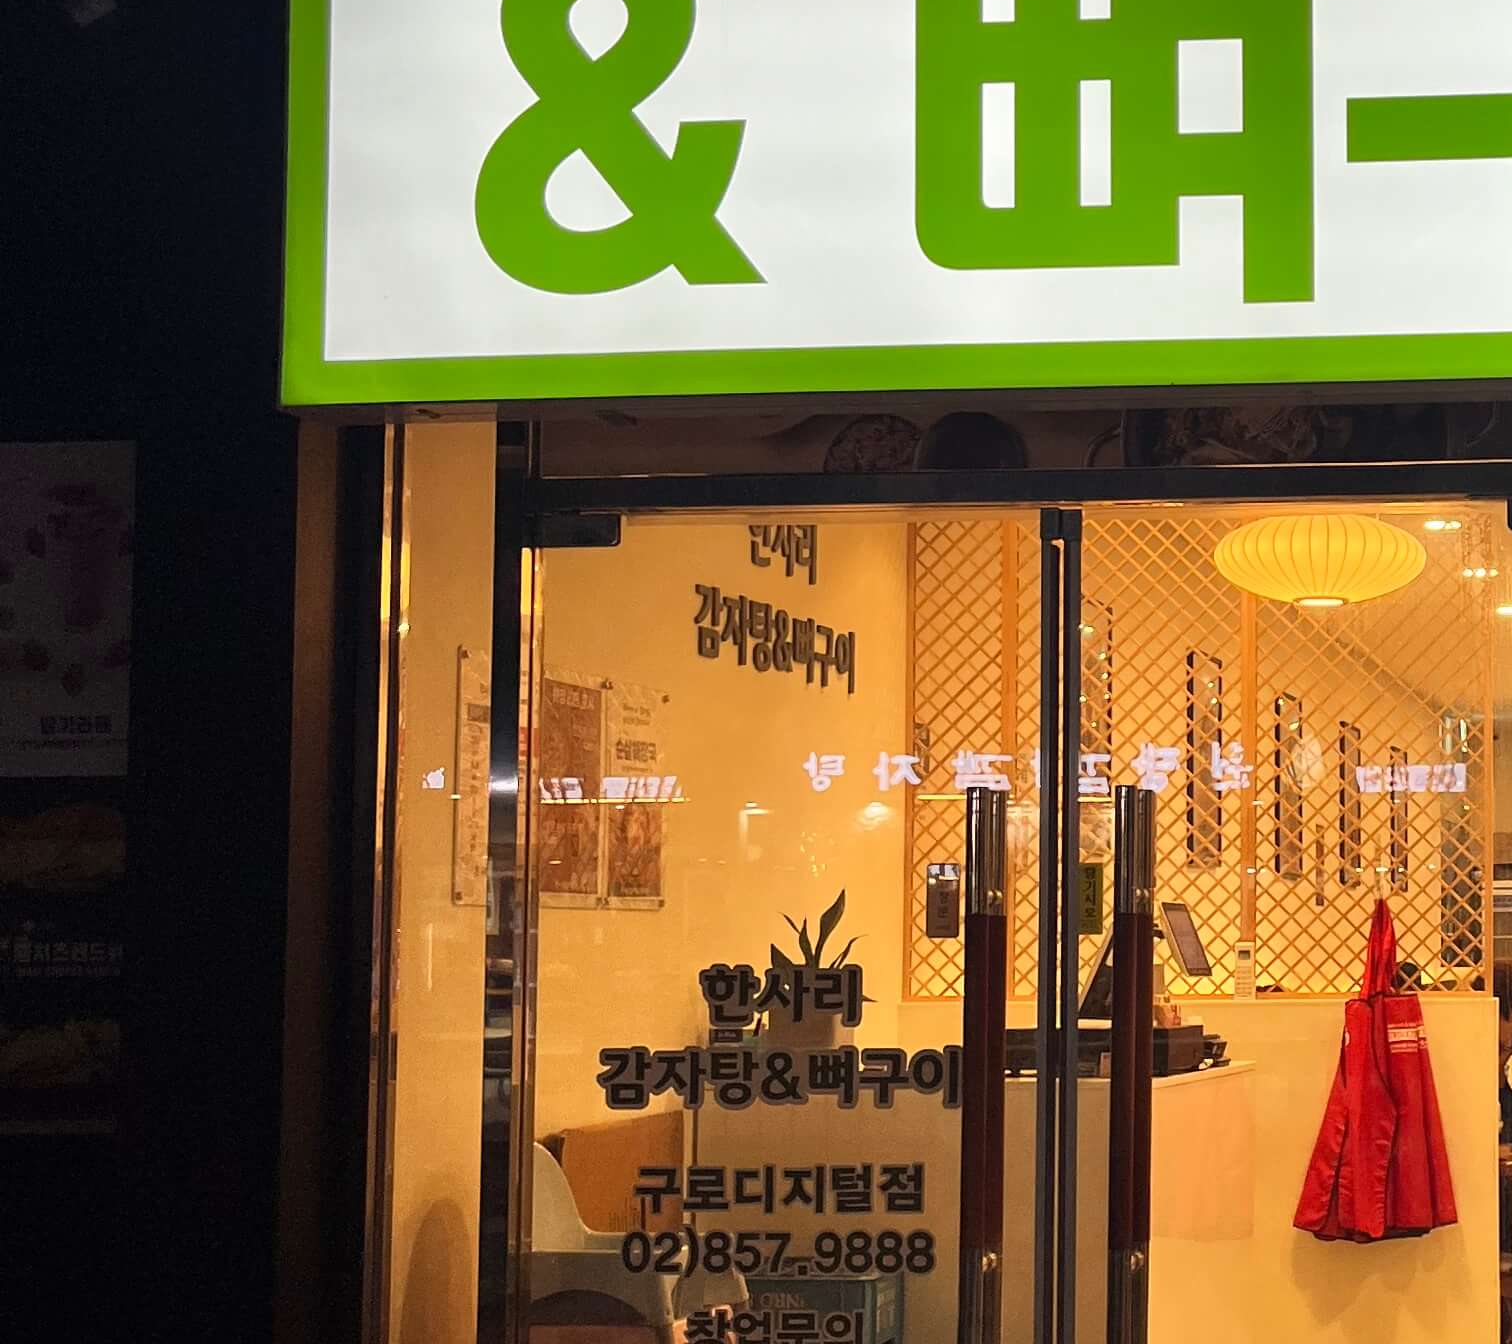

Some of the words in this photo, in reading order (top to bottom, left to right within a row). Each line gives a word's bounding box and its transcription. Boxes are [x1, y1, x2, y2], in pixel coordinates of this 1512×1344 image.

[694, 584, 856, 694] 감자탕&뼈구이
[701, 963, 863, 1026] 한사리
[597, 1045, 962, 1110] 감자탕&뼈구이
[634, 1163, 926, 1215] 구로디지털점
[621, 1231, 935, 1279] 02)857.9888
